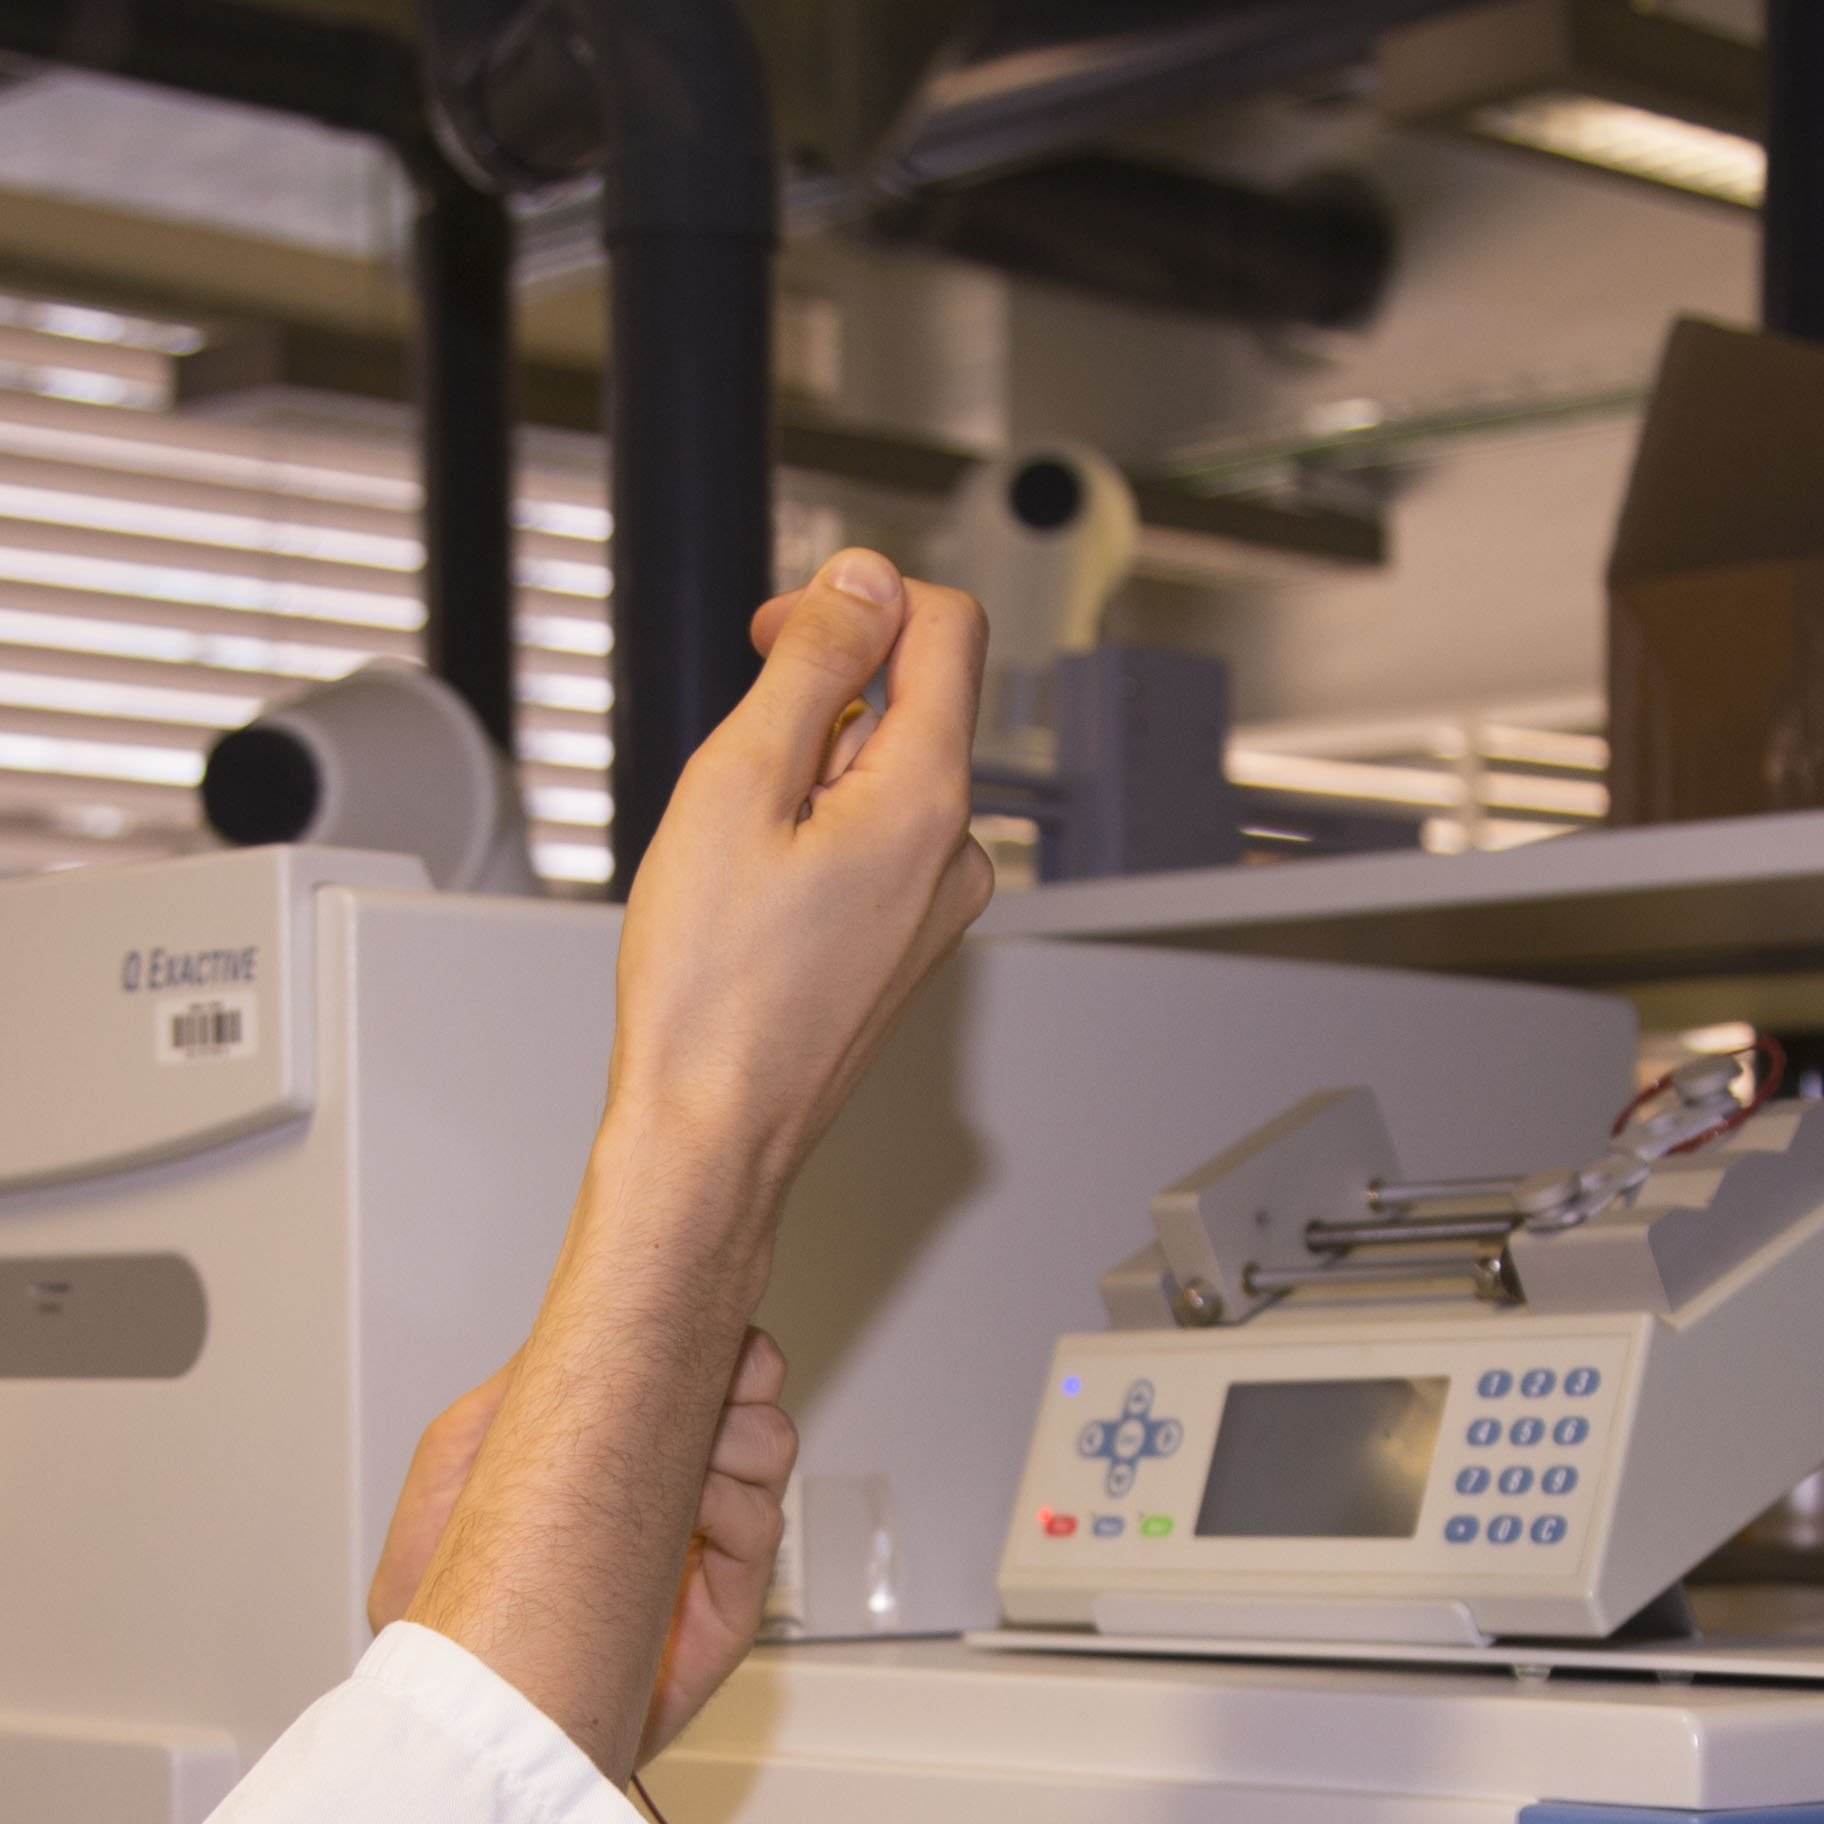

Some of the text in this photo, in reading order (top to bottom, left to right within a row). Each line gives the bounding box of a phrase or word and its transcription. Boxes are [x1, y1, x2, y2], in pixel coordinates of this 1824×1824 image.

[1531, 1371, 1546, 1395] 2
[1574, 1370, 1590, 1393] 3
[1478, 1418, 1578, 1444] 4 5 6
[1465, 1468, 1567, 1492] 7 8 9
[1541, 1517, 1557, 1542] C
